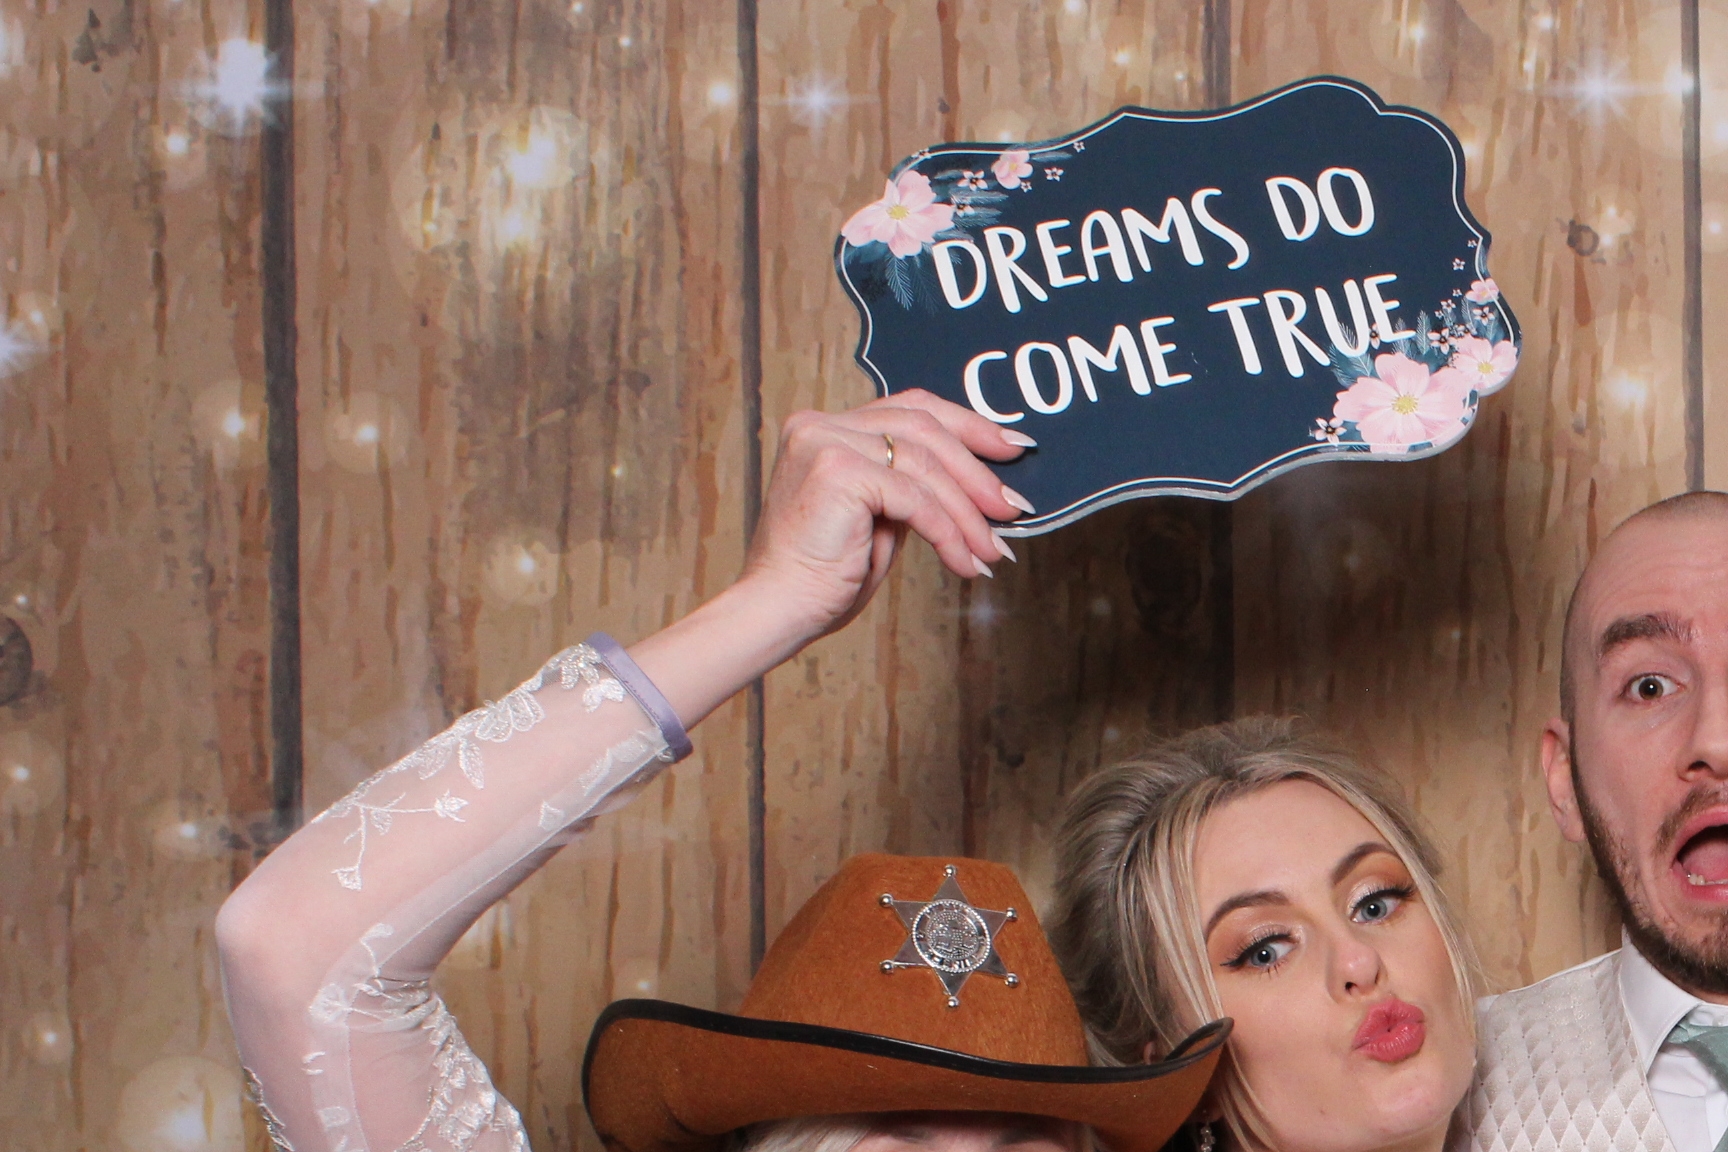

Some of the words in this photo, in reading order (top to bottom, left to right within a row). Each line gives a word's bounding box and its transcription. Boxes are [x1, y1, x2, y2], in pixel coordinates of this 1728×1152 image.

[934, 188, 1250, 312] DREAMS
[1265, 167, 1375, 241] DO
[963, 317, 1192, 423] COME
[1207, 274, 1416, 378] TRUE
